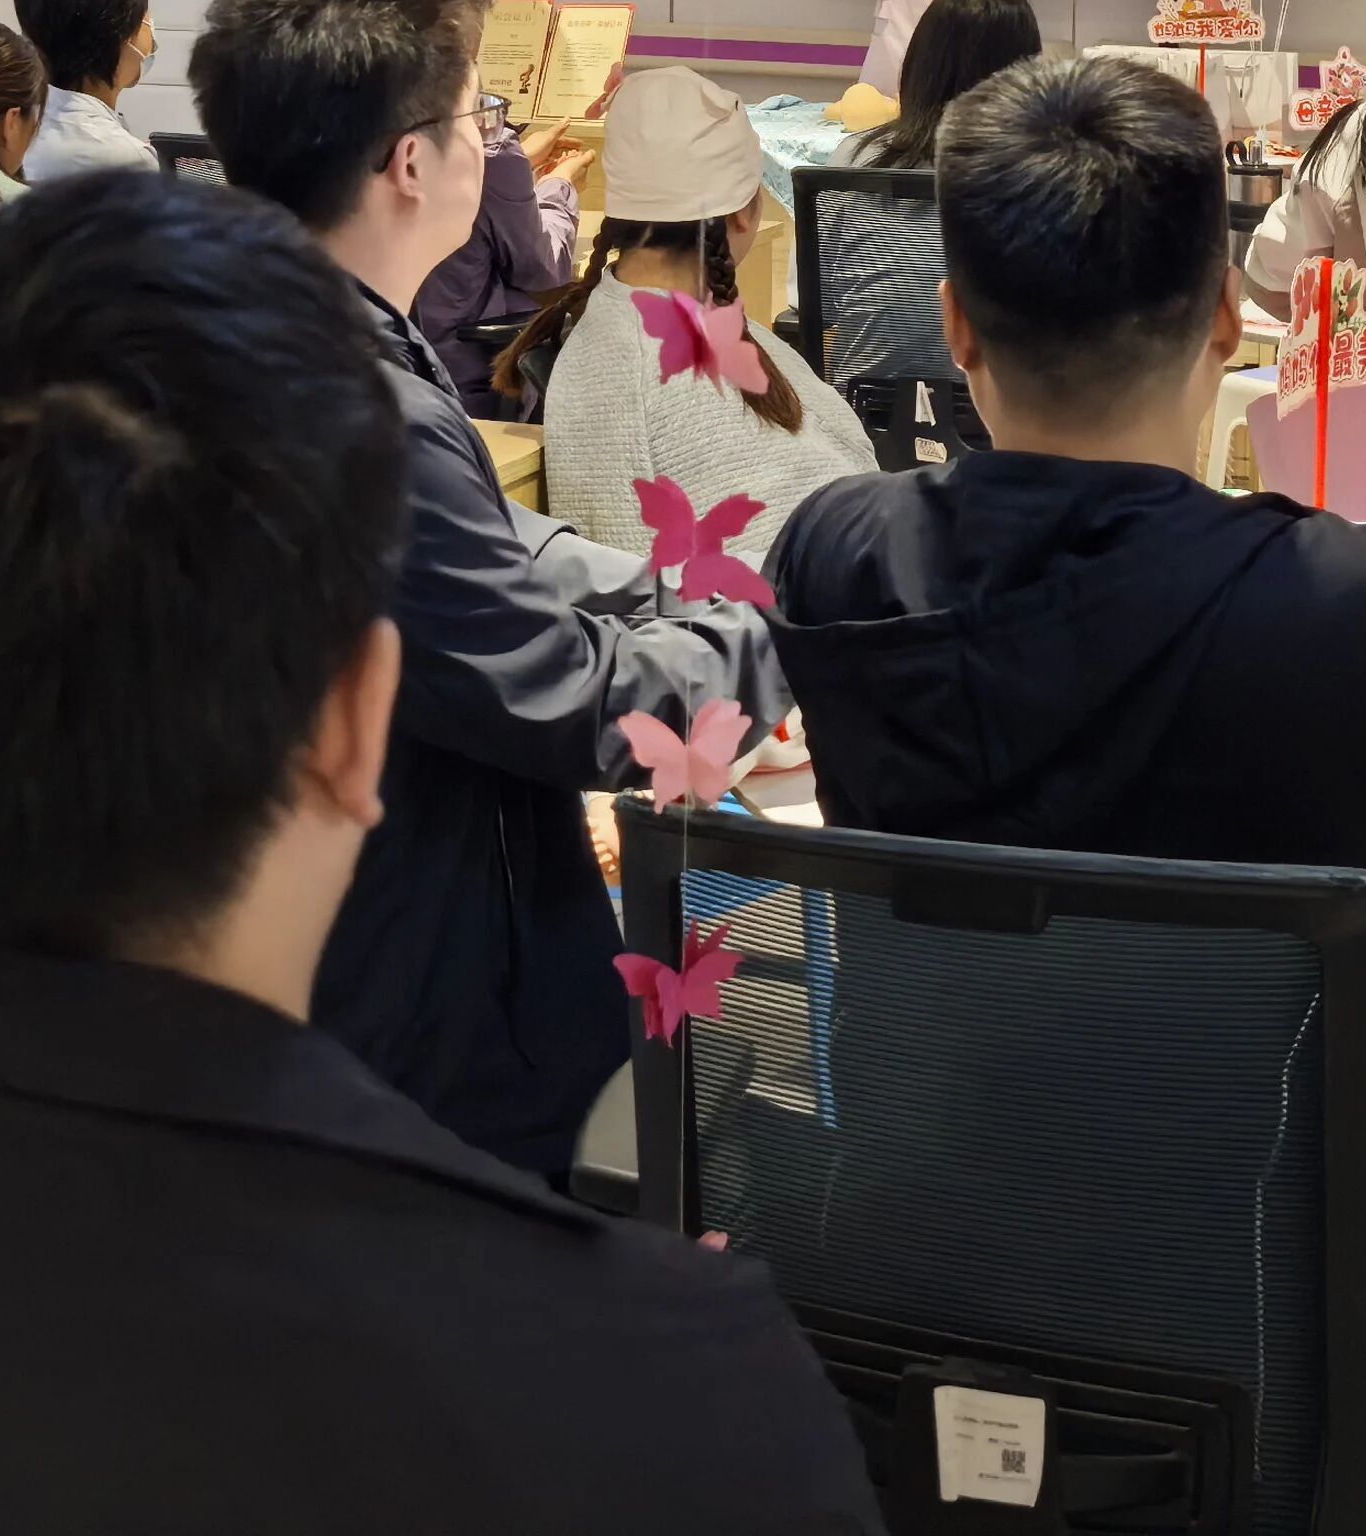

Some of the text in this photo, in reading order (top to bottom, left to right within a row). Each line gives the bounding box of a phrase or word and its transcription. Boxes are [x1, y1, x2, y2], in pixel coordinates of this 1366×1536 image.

[1153, 17, 1263, 40] 妈妈我爱你
